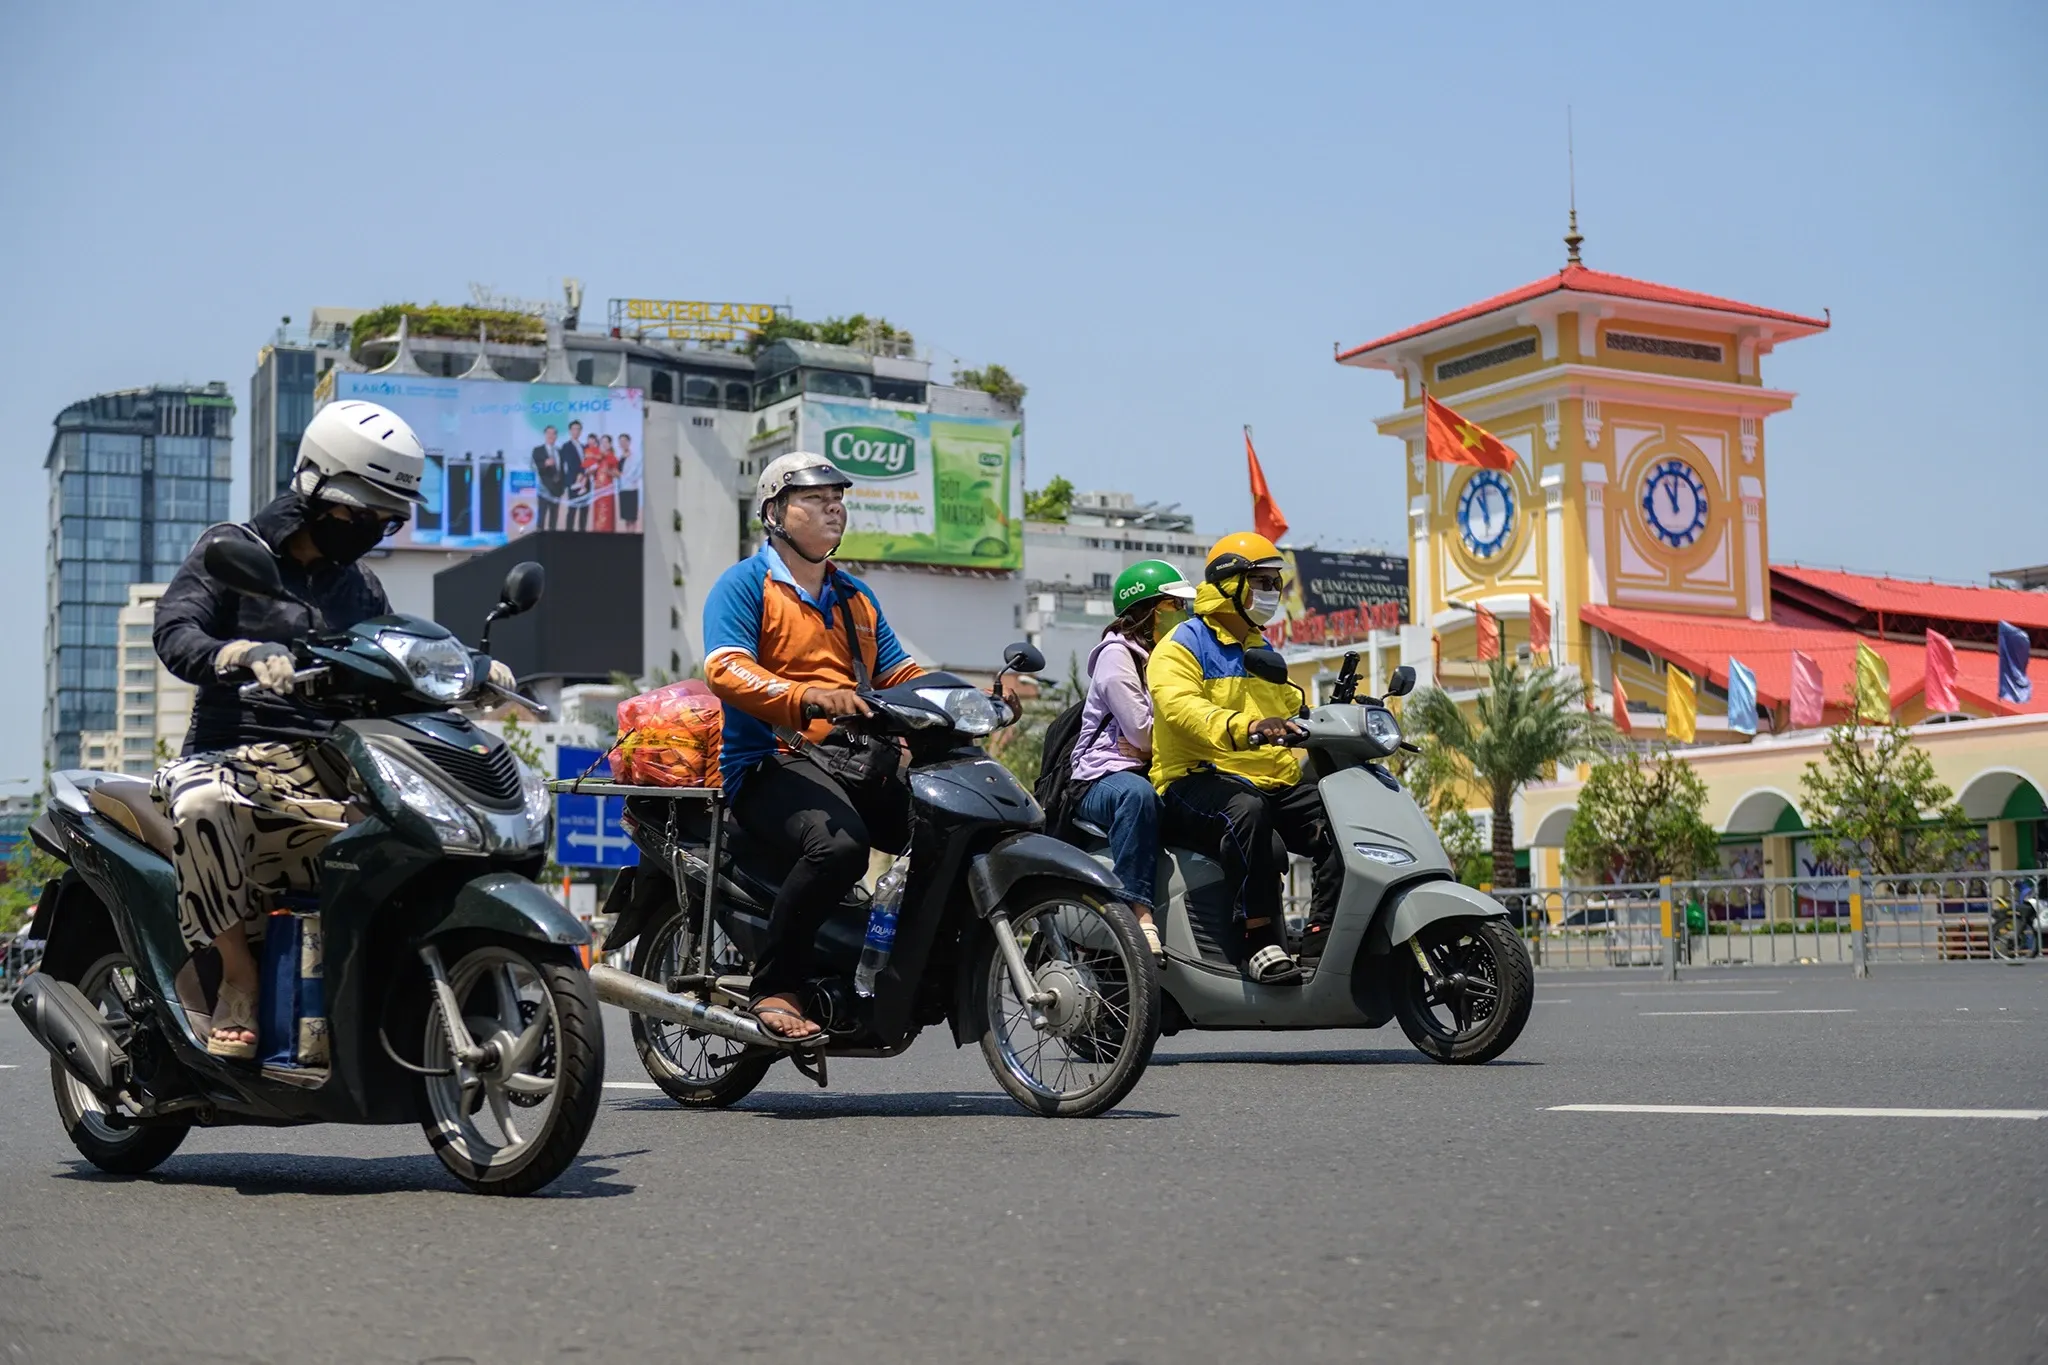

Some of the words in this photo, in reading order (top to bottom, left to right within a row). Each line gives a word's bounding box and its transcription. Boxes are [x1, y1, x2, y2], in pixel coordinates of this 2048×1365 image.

[627, 299, 774, 324] SILVERLAND
[831, 432, 907, 471] Cozy
[1119, 581, 1146, 600] Grab
[324, 860, 360, 871] HONDA
